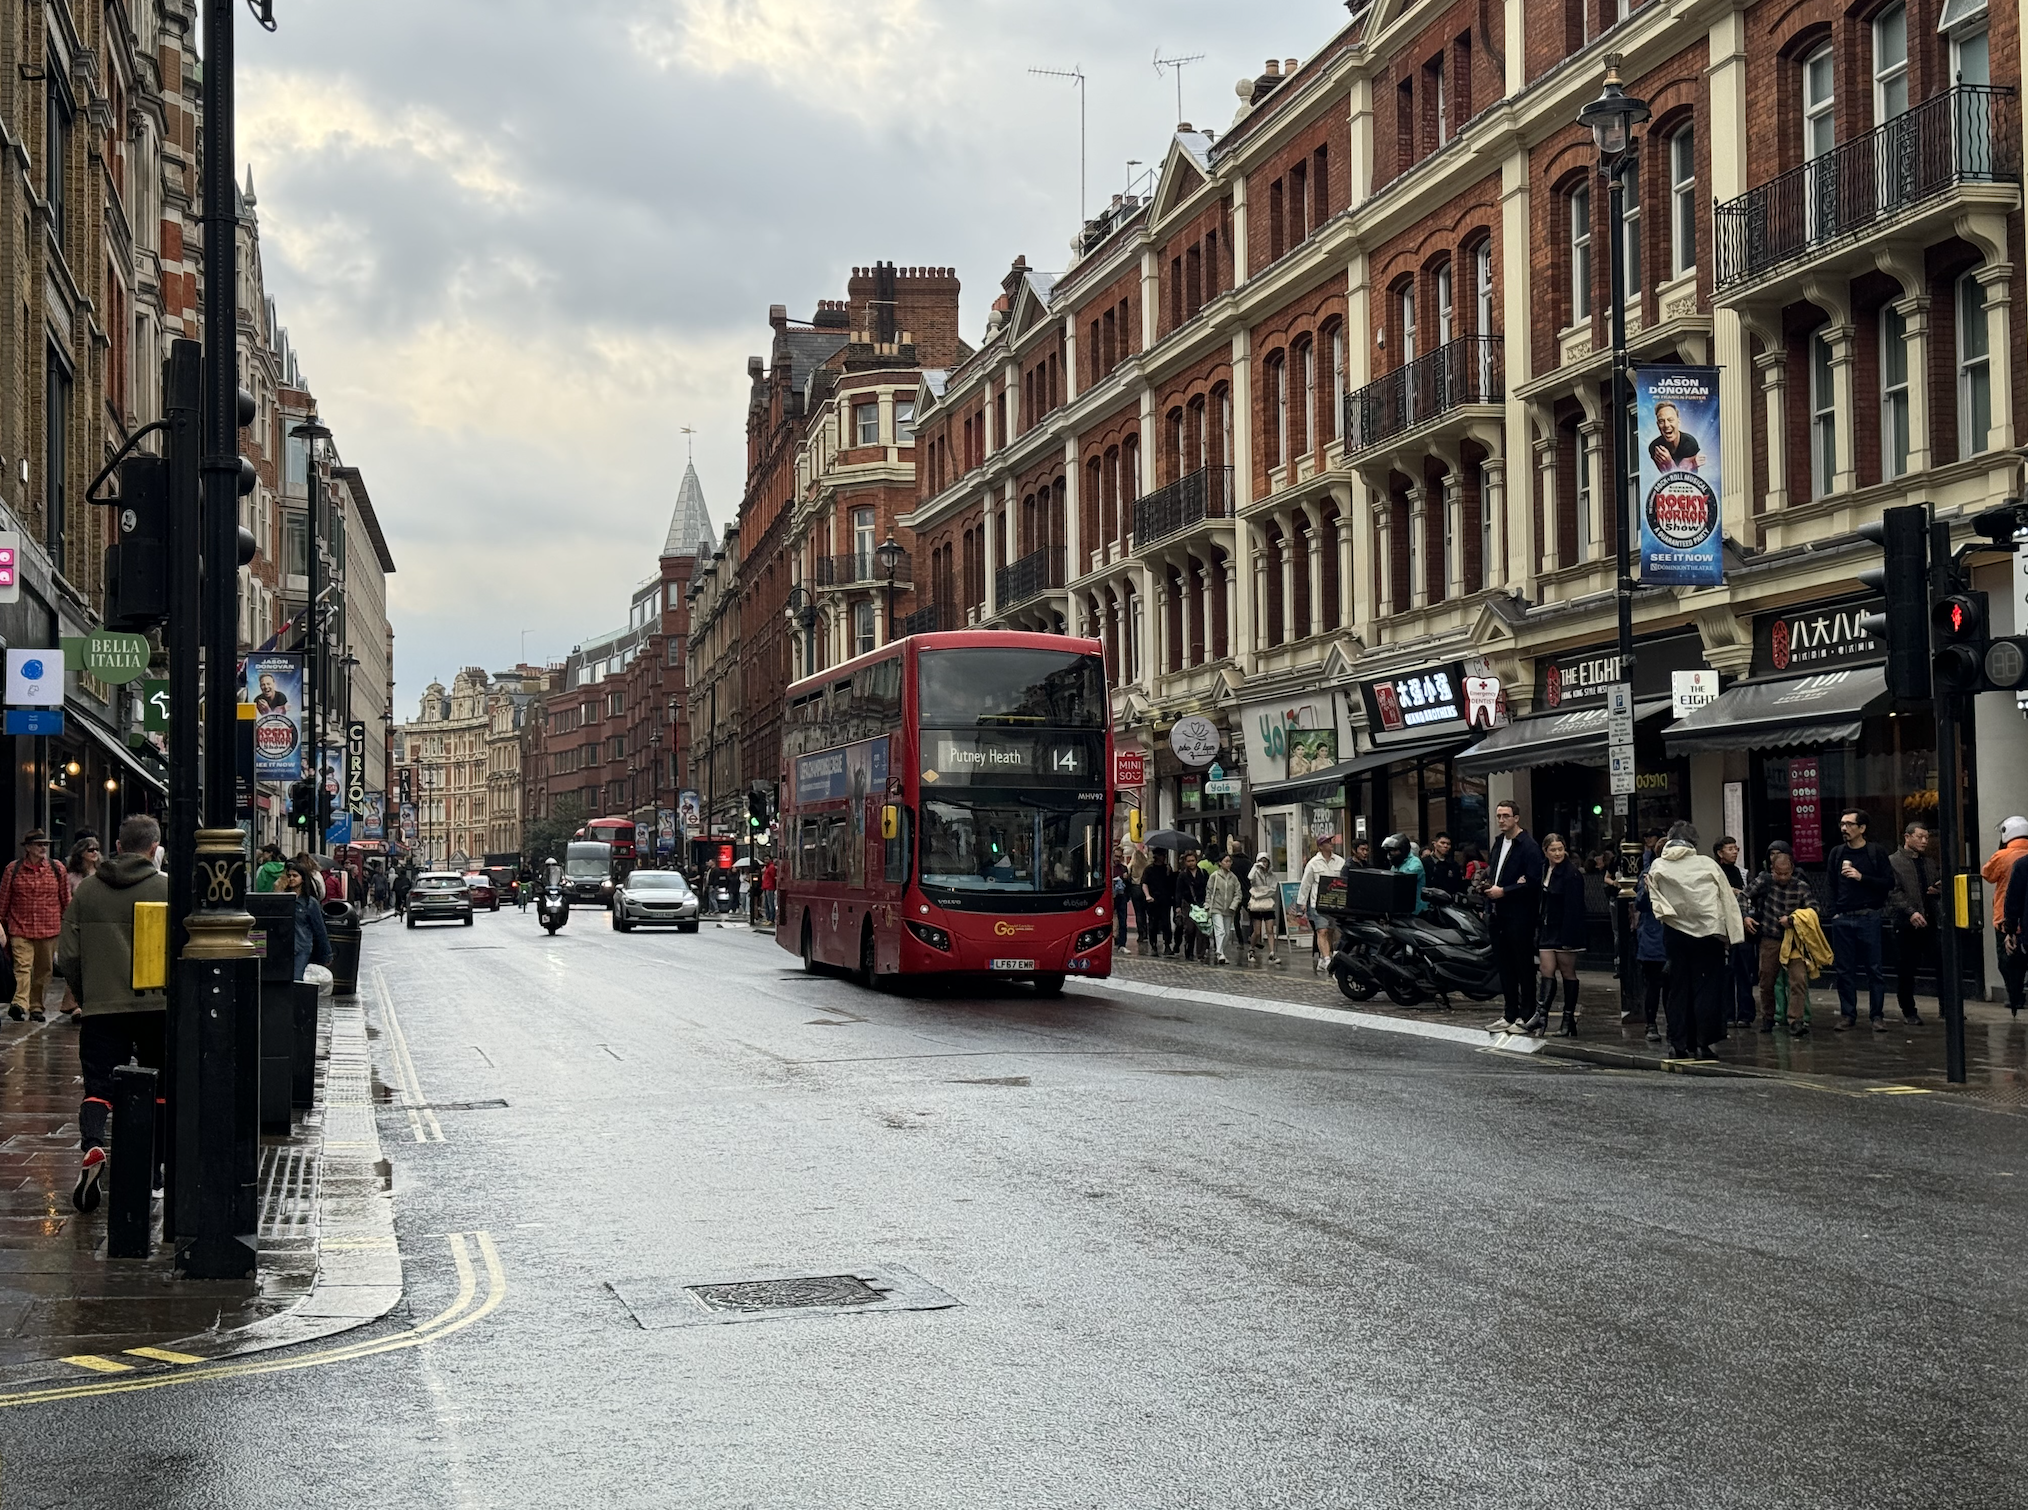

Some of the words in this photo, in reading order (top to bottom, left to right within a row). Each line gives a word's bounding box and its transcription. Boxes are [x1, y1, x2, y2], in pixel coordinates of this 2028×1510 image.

[1658, 378, 1699, 386] JASON
[1648, 386, 1709, 395] DONOVAN
[1684, 474, 1708, 492] MUSICAL
[1656, 494, 1710, 511] ROCKY
[1656, 510, 1708, 525] HORROR
[1665, 524, 1699, 532] Show
[1657, 530, 1694, 548] GUARANTEED
[1693, 527, 1710, 545] PARTY
[1650, 554, 1672, 562] SEE
[1674, 554, 1684, 562] IT
[1685, 554, 1714, 562] NOW
[91, 639, 140, 653] BELLA
[90, 654, 141, 668] ITALIA
[1560, 666, 1578, 687] THE
[1580, 656, 1621, 686] EIGHT
[1681, 695, 1716, 705] EIGHT
[950, 748, 986, 766] Putney
[990, 749, 1021, 764] Heath
[1052, 749, 1078, 772] 14
[349, 725, 364, 816] CURZON
[1119, 761, 1141, 770] MINI
[1313, 808, 1330, 823] ZERO
[1310, 822, 1334, 838] SUGAR
[994, 921, 1015, 936] Go
[995, 960, 1017, 969] LF67
